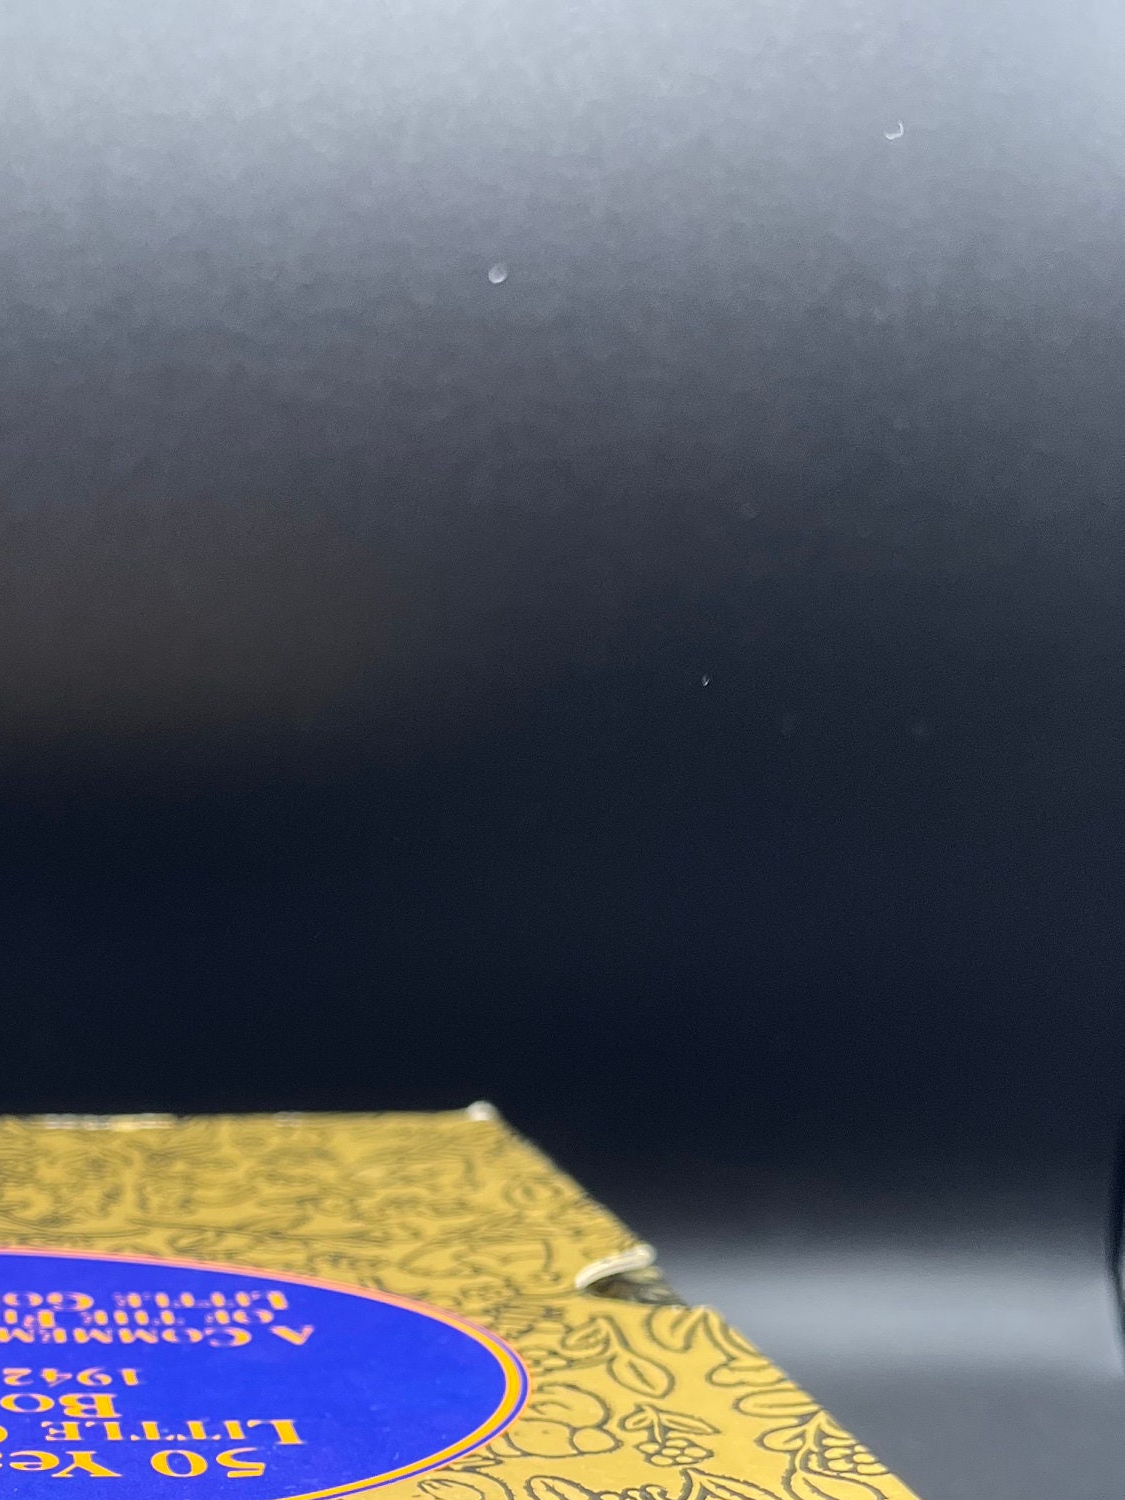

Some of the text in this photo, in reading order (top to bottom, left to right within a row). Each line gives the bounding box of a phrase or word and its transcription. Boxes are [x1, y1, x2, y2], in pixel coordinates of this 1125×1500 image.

[113, 1290, 289, 1312] LITTLE
[82, 1308, 185, 1327] THE
[204, 1308, 274, 1325] OF
[269, 1324, 315, 1346] A
[41, 1419, 305, 1445] LITTLE
[150, 1449, 266, 1478] 50
